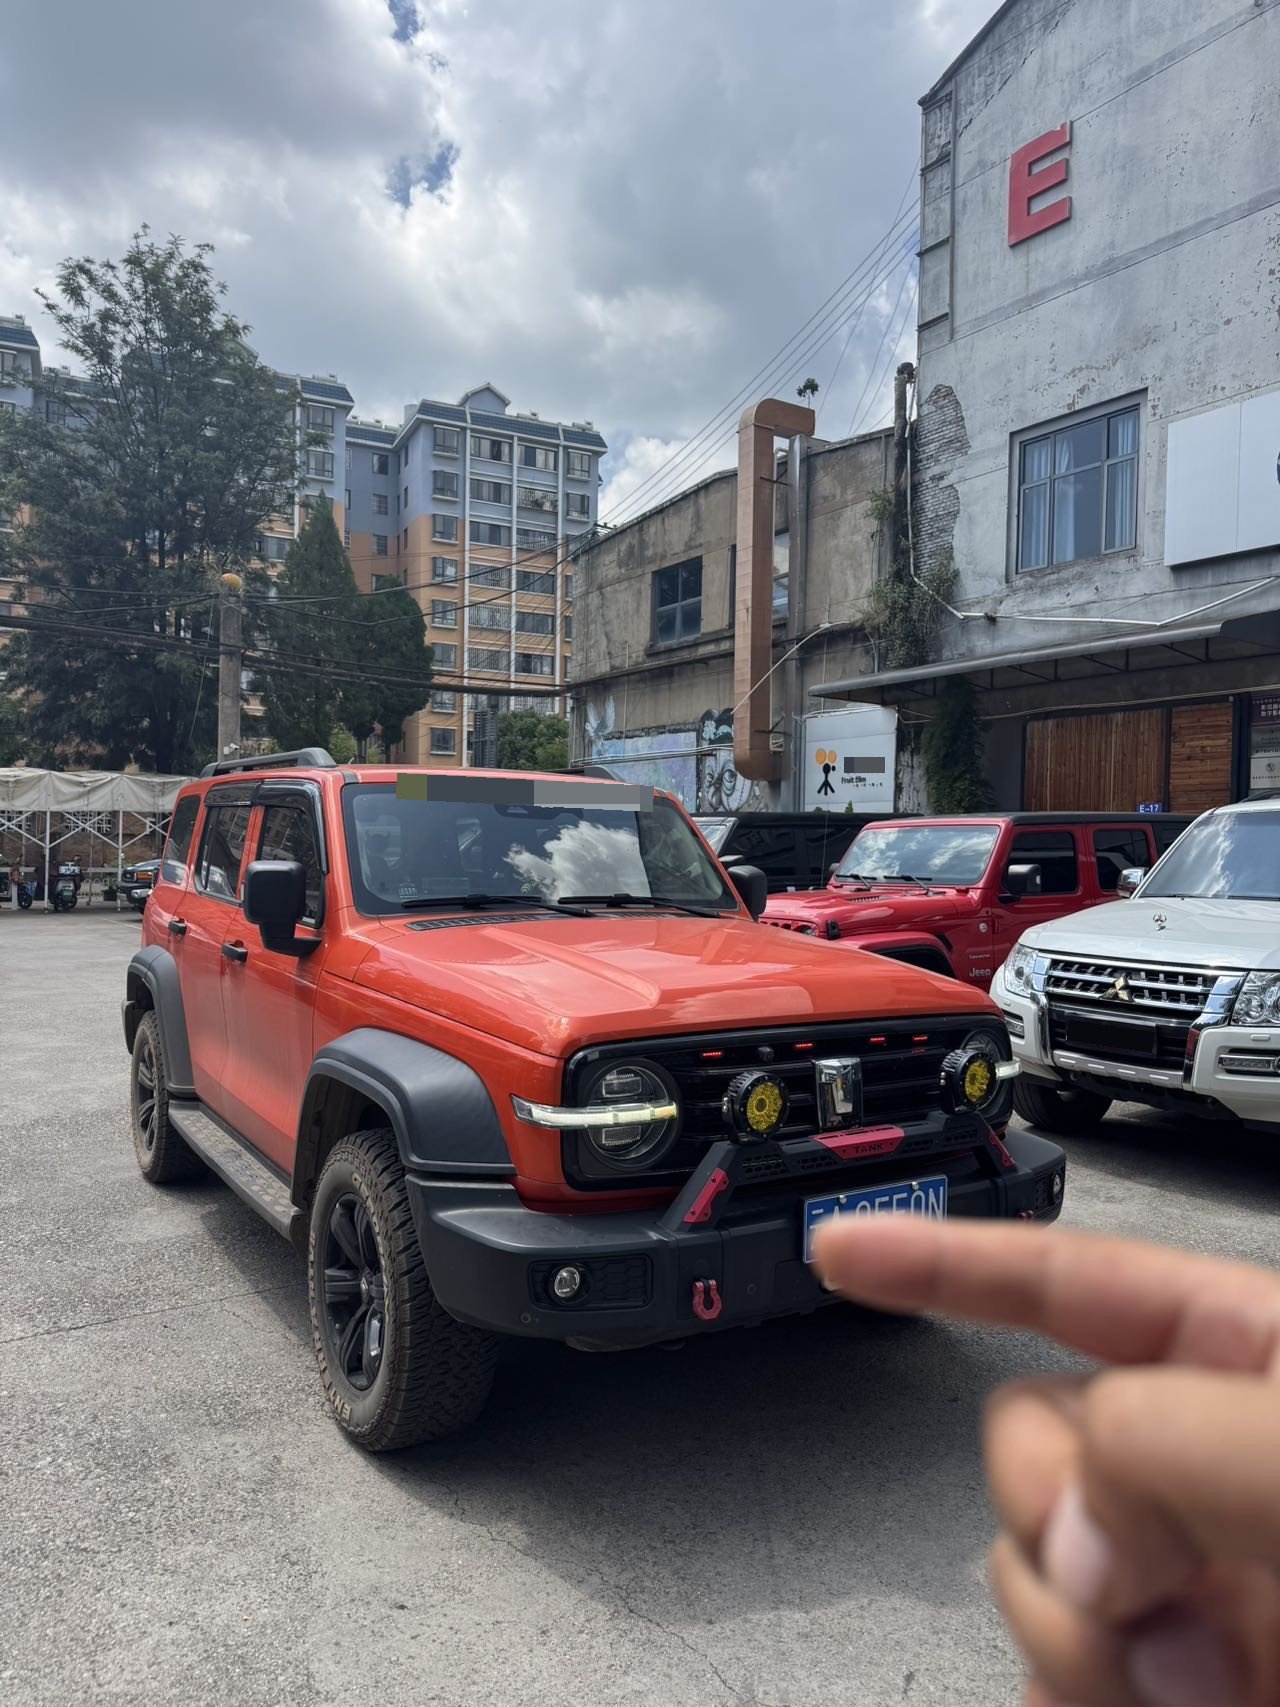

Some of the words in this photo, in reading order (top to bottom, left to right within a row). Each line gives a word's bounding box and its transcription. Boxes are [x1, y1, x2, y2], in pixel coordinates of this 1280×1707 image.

[1139, 804, 1159, 813] E-17
[969, 967, 991, 978] Jeep
[854, 1143, 884, 1154] TANK
